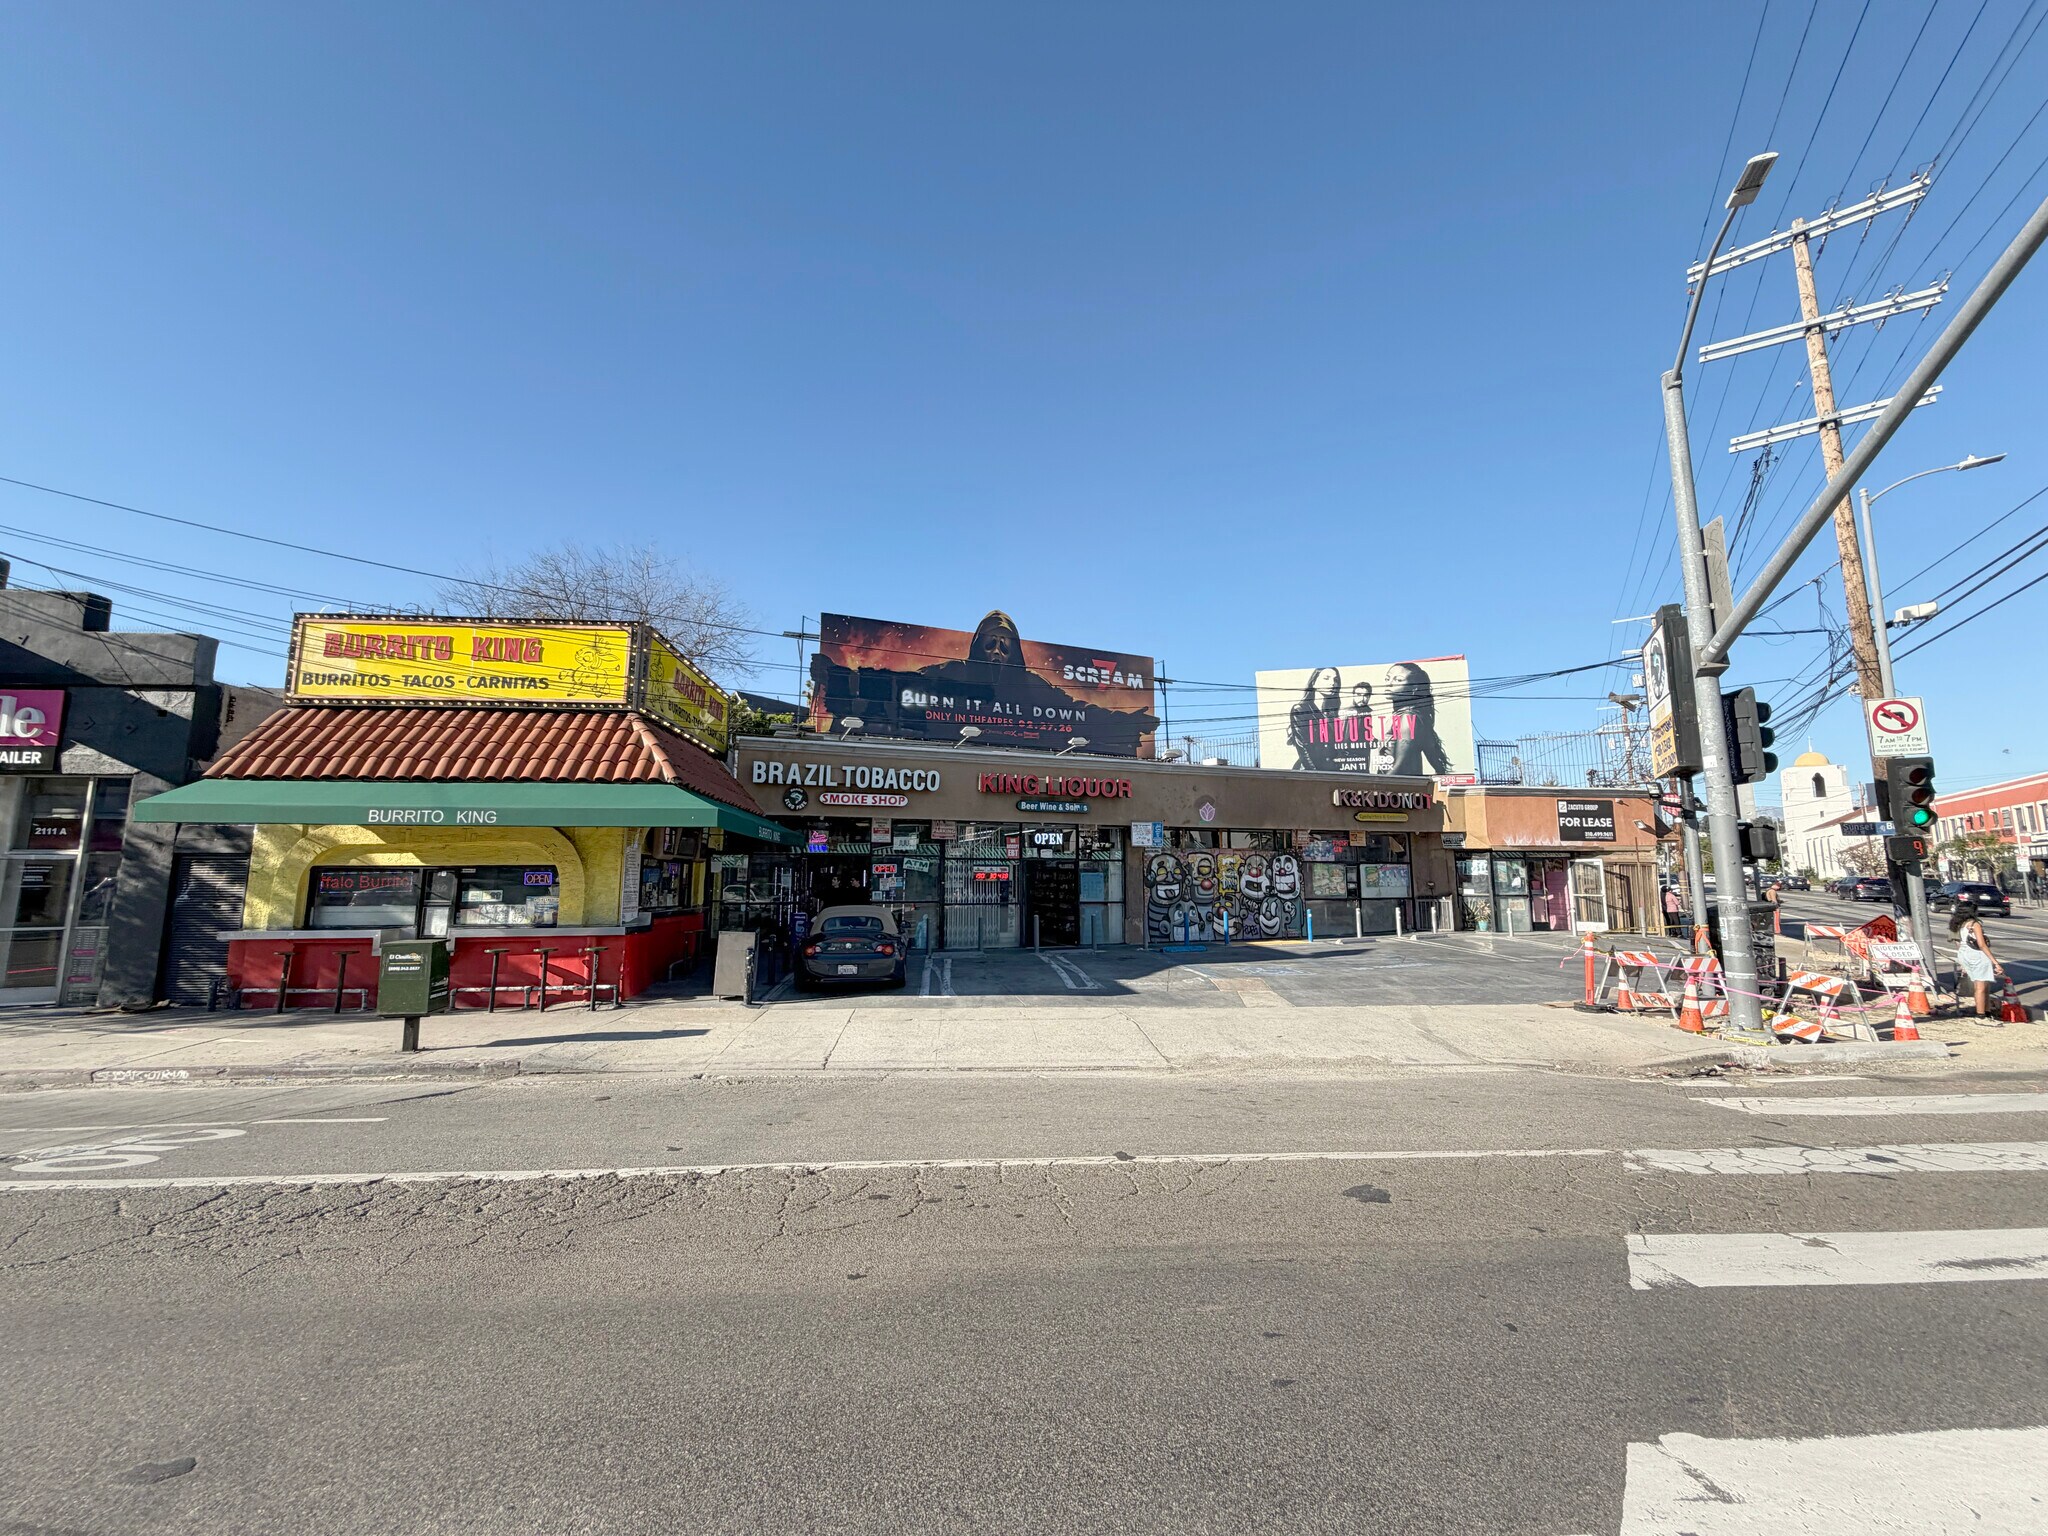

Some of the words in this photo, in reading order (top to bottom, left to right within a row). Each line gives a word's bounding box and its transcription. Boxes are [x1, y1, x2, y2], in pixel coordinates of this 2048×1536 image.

[323, 632, 454, 660] BURRITO
[471, 635, 545, 663] KING
[302, 671, 391, 687] BURRITOS
[403, 674, 455, 689] TACOS
[466, 675, 549, 690] CARNITAS
[1063, 664, 1144, 689] SCREAM
[902, 689, 954, 709] BURN
[966, 699, 982, 711] IT
[992, 702, 1023, 715] ALL
[1033, 706, 1087, 722] DOWN
[925, 710, 951, 721] ONLY
[955, 714, 966, 723] IN
[969, 714, 1014, 727] THEATRES
[1309, 714, 1417, 743] INDUSTRY
[1339, 763, 1357, 771] JAN
[752, 760, 838, 787] BRAZIL
[842, 765, 941, 792] TOBACCO
[979, 772, 1040, 795] KING
[1046, 775, 1134, 798] LIQUOR
[822, 793, 868, 804] SMOKE
[871, 795, 906, 805] SHOP
[1021, 801, 1038, 810] Beer
[1039, 802, 1057, 811] Wine
[1058, 803, 1063, 811] &
[1377, 790, 1433, 810] DONUT
[368, 809, 444, 823] BURRITO
[456, 810, 498, 824] KING
[1560, 817, 1581, 828] FOR
[1582, 817, 1613, 828] LEASE
[1843, 823, 1874, 831] Sunset
[1034, 832, 1063, 845] OPEN
[1008, 849, 1019, 857] EBT
[1913, 840, 1924, 856] 9
[874, 864, 896, 873] OPEN
[904, 859, 929, 869] ATM
[526, 874, 551, 884] OPEN
[1634, 995, 1672, 1006] HARM
